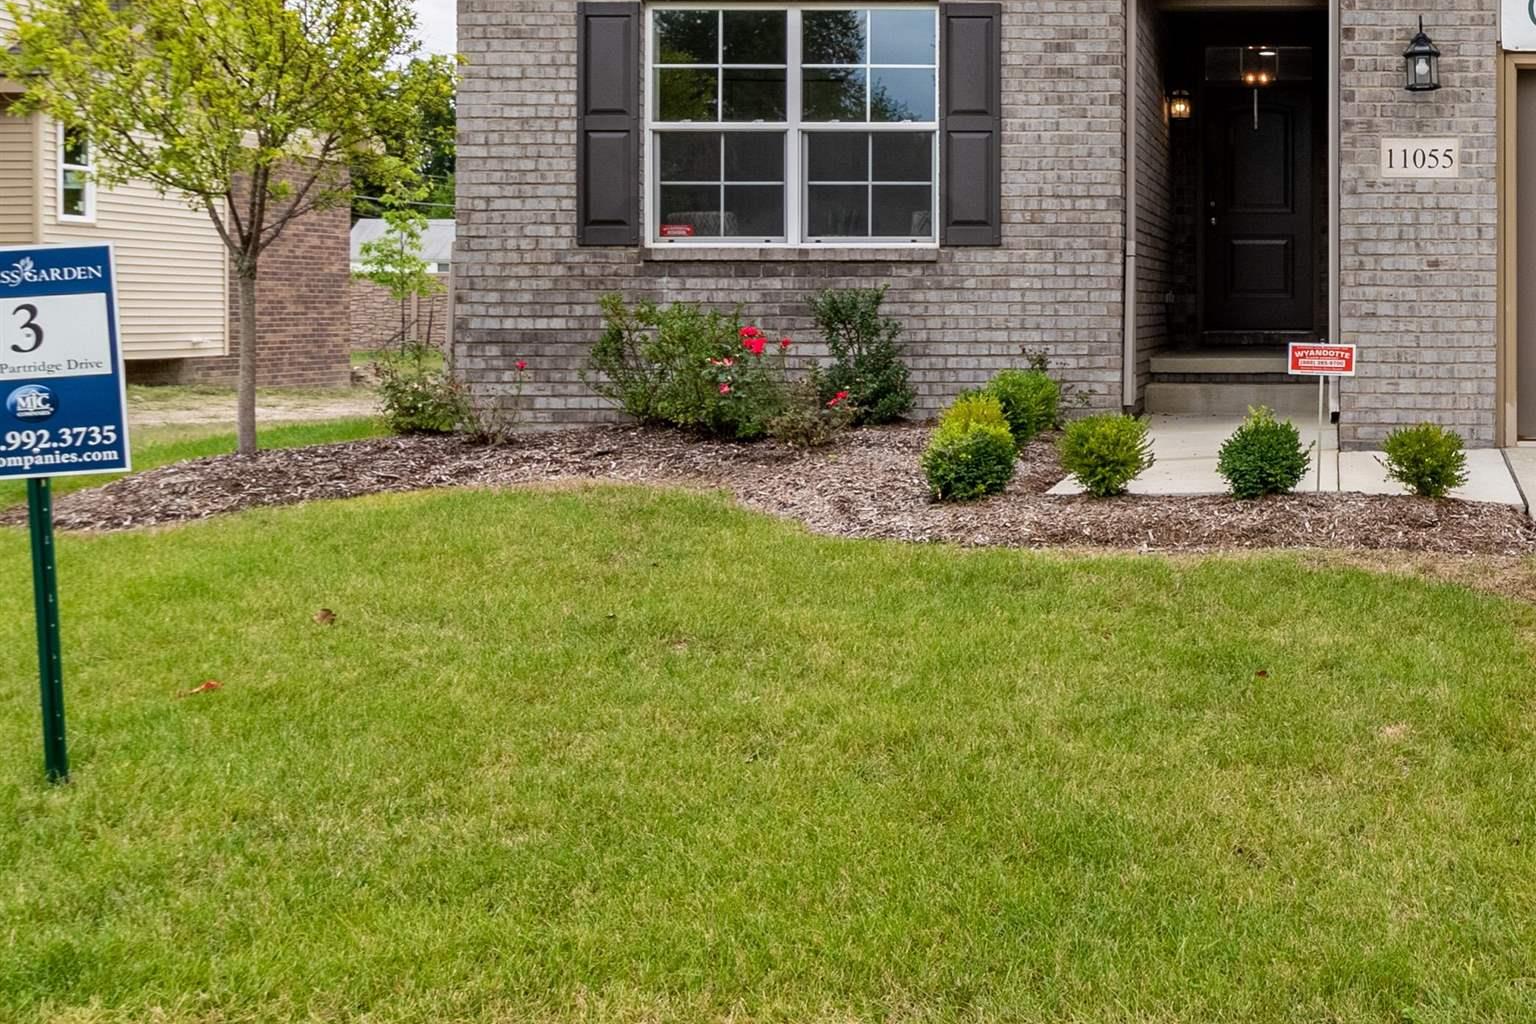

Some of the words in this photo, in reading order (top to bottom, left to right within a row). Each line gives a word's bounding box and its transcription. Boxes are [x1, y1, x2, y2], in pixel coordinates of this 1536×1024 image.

[1387, 148, 1454, 169] 11055
[24, 265, 103, 282] GARDEN
[11, 303, 44, 353] 3
[1294, 349, 1351, 359] WYANDOTTE
[0, 360, 62, 375] Partridge
[67, 358, 103, 370] Drive
